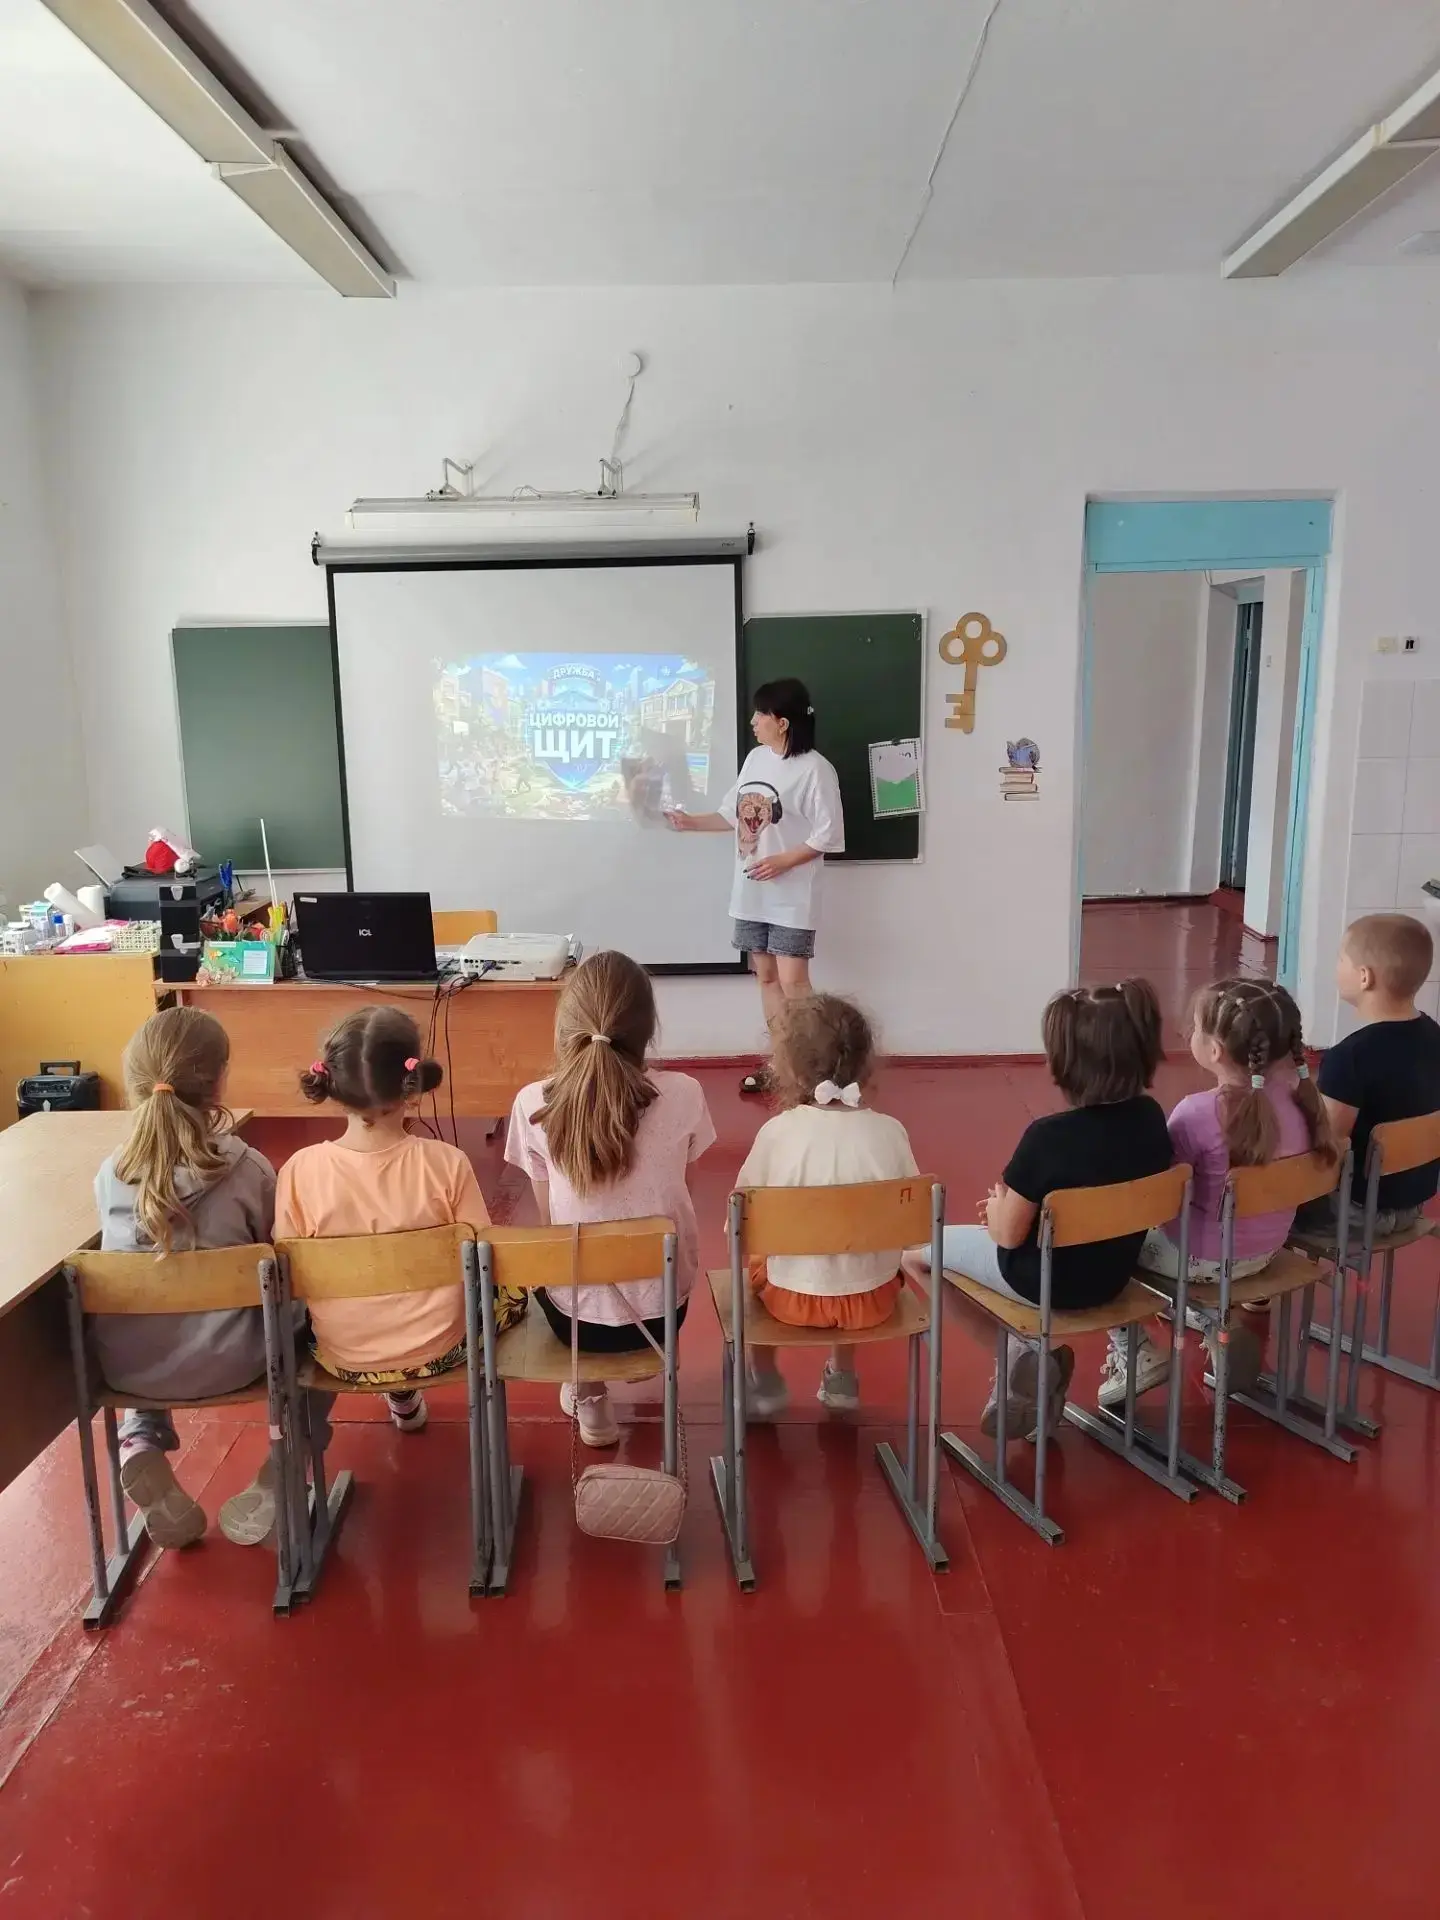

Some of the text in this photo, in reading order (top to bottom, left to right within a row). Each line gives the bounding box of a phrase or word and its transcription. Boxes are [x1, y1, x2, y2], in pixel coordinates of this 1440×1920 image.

[553, 664, 595, 680] ДРУЖБА
[529, 711, 619, 728] ЦИФРОВОЙ
[534, 729, 617, 763] ЩИТ
